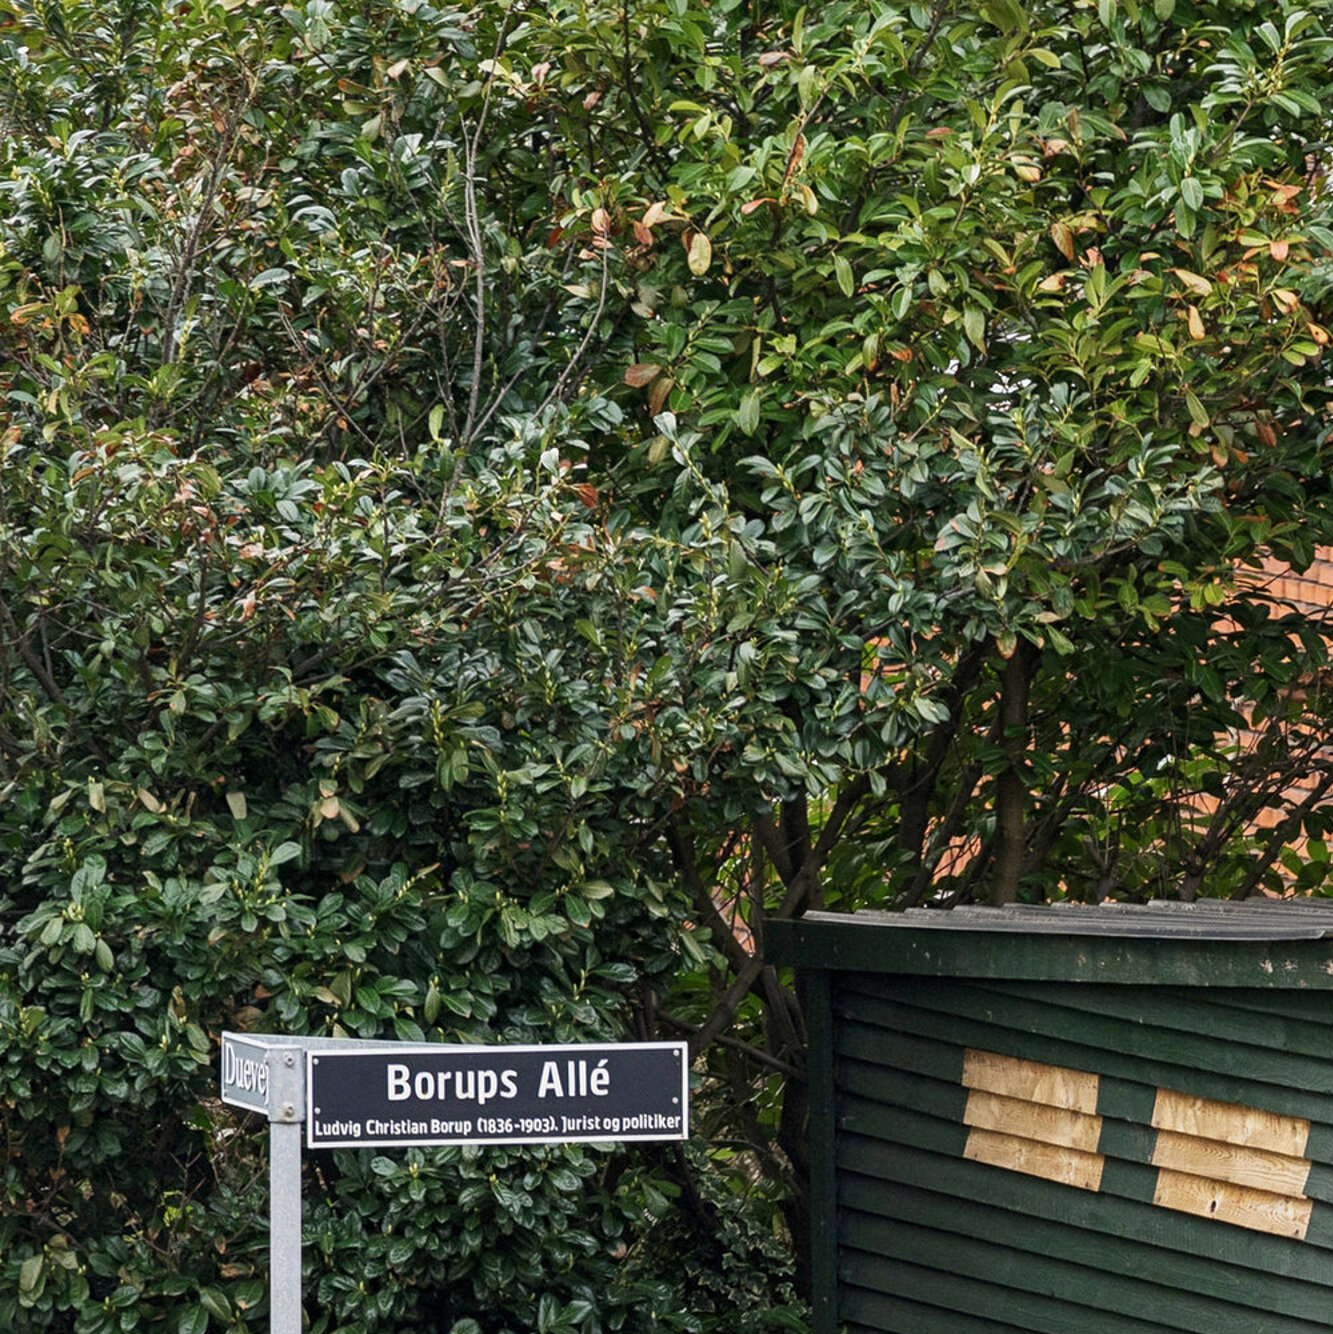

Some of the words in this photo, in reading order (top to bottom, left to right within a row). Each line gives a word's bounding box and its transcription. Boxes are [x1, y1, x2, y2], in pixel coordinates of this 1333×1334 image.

[388, 1064, 518, 1105] Borups
[538, 1059, 611, 1099] Allé
[315, 1119, 361, 1137] Ludvig
[366, 1118, 428, 1135] Christian
[431, 1118, 472, 1136] Borup
[561, 1114, 601, 1133] Jurist
[603, 1119, 620, 1133] og
[622, 1113, 682, 1134] politiker
